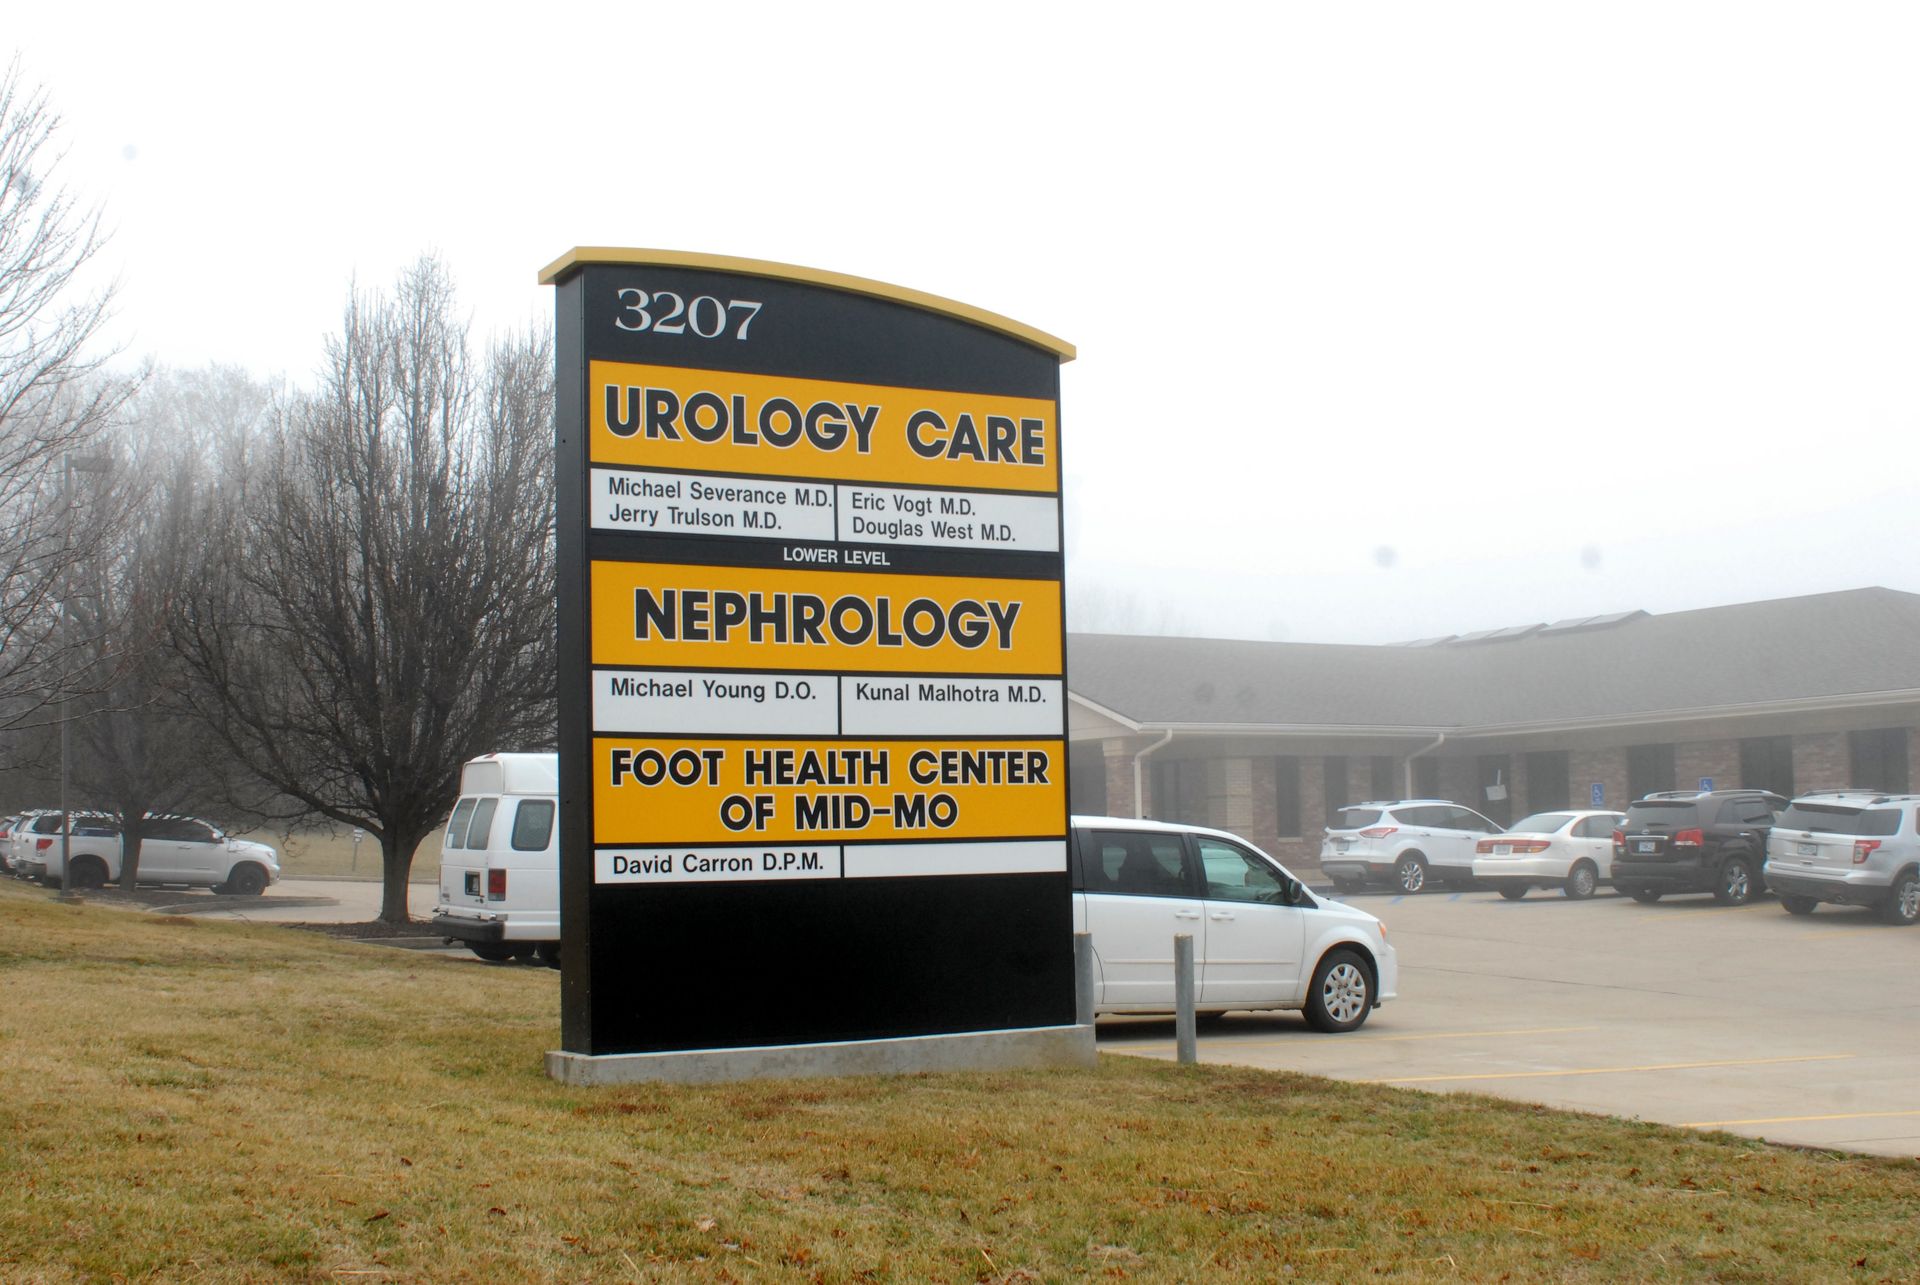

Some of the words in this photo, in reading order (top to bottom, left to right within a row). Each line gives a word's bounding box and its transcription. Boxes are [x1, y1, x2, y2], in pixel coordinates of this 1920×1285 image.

[615, 287, 762, 340] 3207
[605, 384, 880, 454] UROLOGY
[906, 410, 1045, 465] CARE
[608, 477, 681, 499] Michael
[690, 481, 787, 505] Severance
[795, 488, 833, 507] M.D.
[852, 492, 885, 511] Eric
[893, 494, 932, 517] Vogt
[940, 497, 975, 515] M.D.
[609, 504, 657, 527] Jerry
[667, 507, 734, 526] Trulson
[743, 511, 782, 529] M.D.
[852, 517, 924, 539] Douglas
[931, 521, 974, 539] West
[981, 524, 1015, 541] M.D.
[783, 547, 838, 563] LOWER
[844, 549, 890, 566] LEVEL
[634, 588, 1021, 650] NEPHROLOGY
[611, 678, 693, 698] Michael
[703, 680, 765, 702] Young
[775, 681, 816, 700] D.O.
[856, 683, 910, 701] Kunal
[918, 684, 999, 702] Malhotra
[1008, 685, 1046, 703] M.D.
[611, 748, 725, 787] FOOT
[745, 749, 889, 786] HEALTH
[908, 749, 1051, 785] CENTER
[719, 793, 775, 832] OF
[795, 792, 959, 830] MID-MO
[613, 854, 673, 874] David
[682, 853, 753, 872] Carron
[763, 852, 823, 871] D.P.M.
